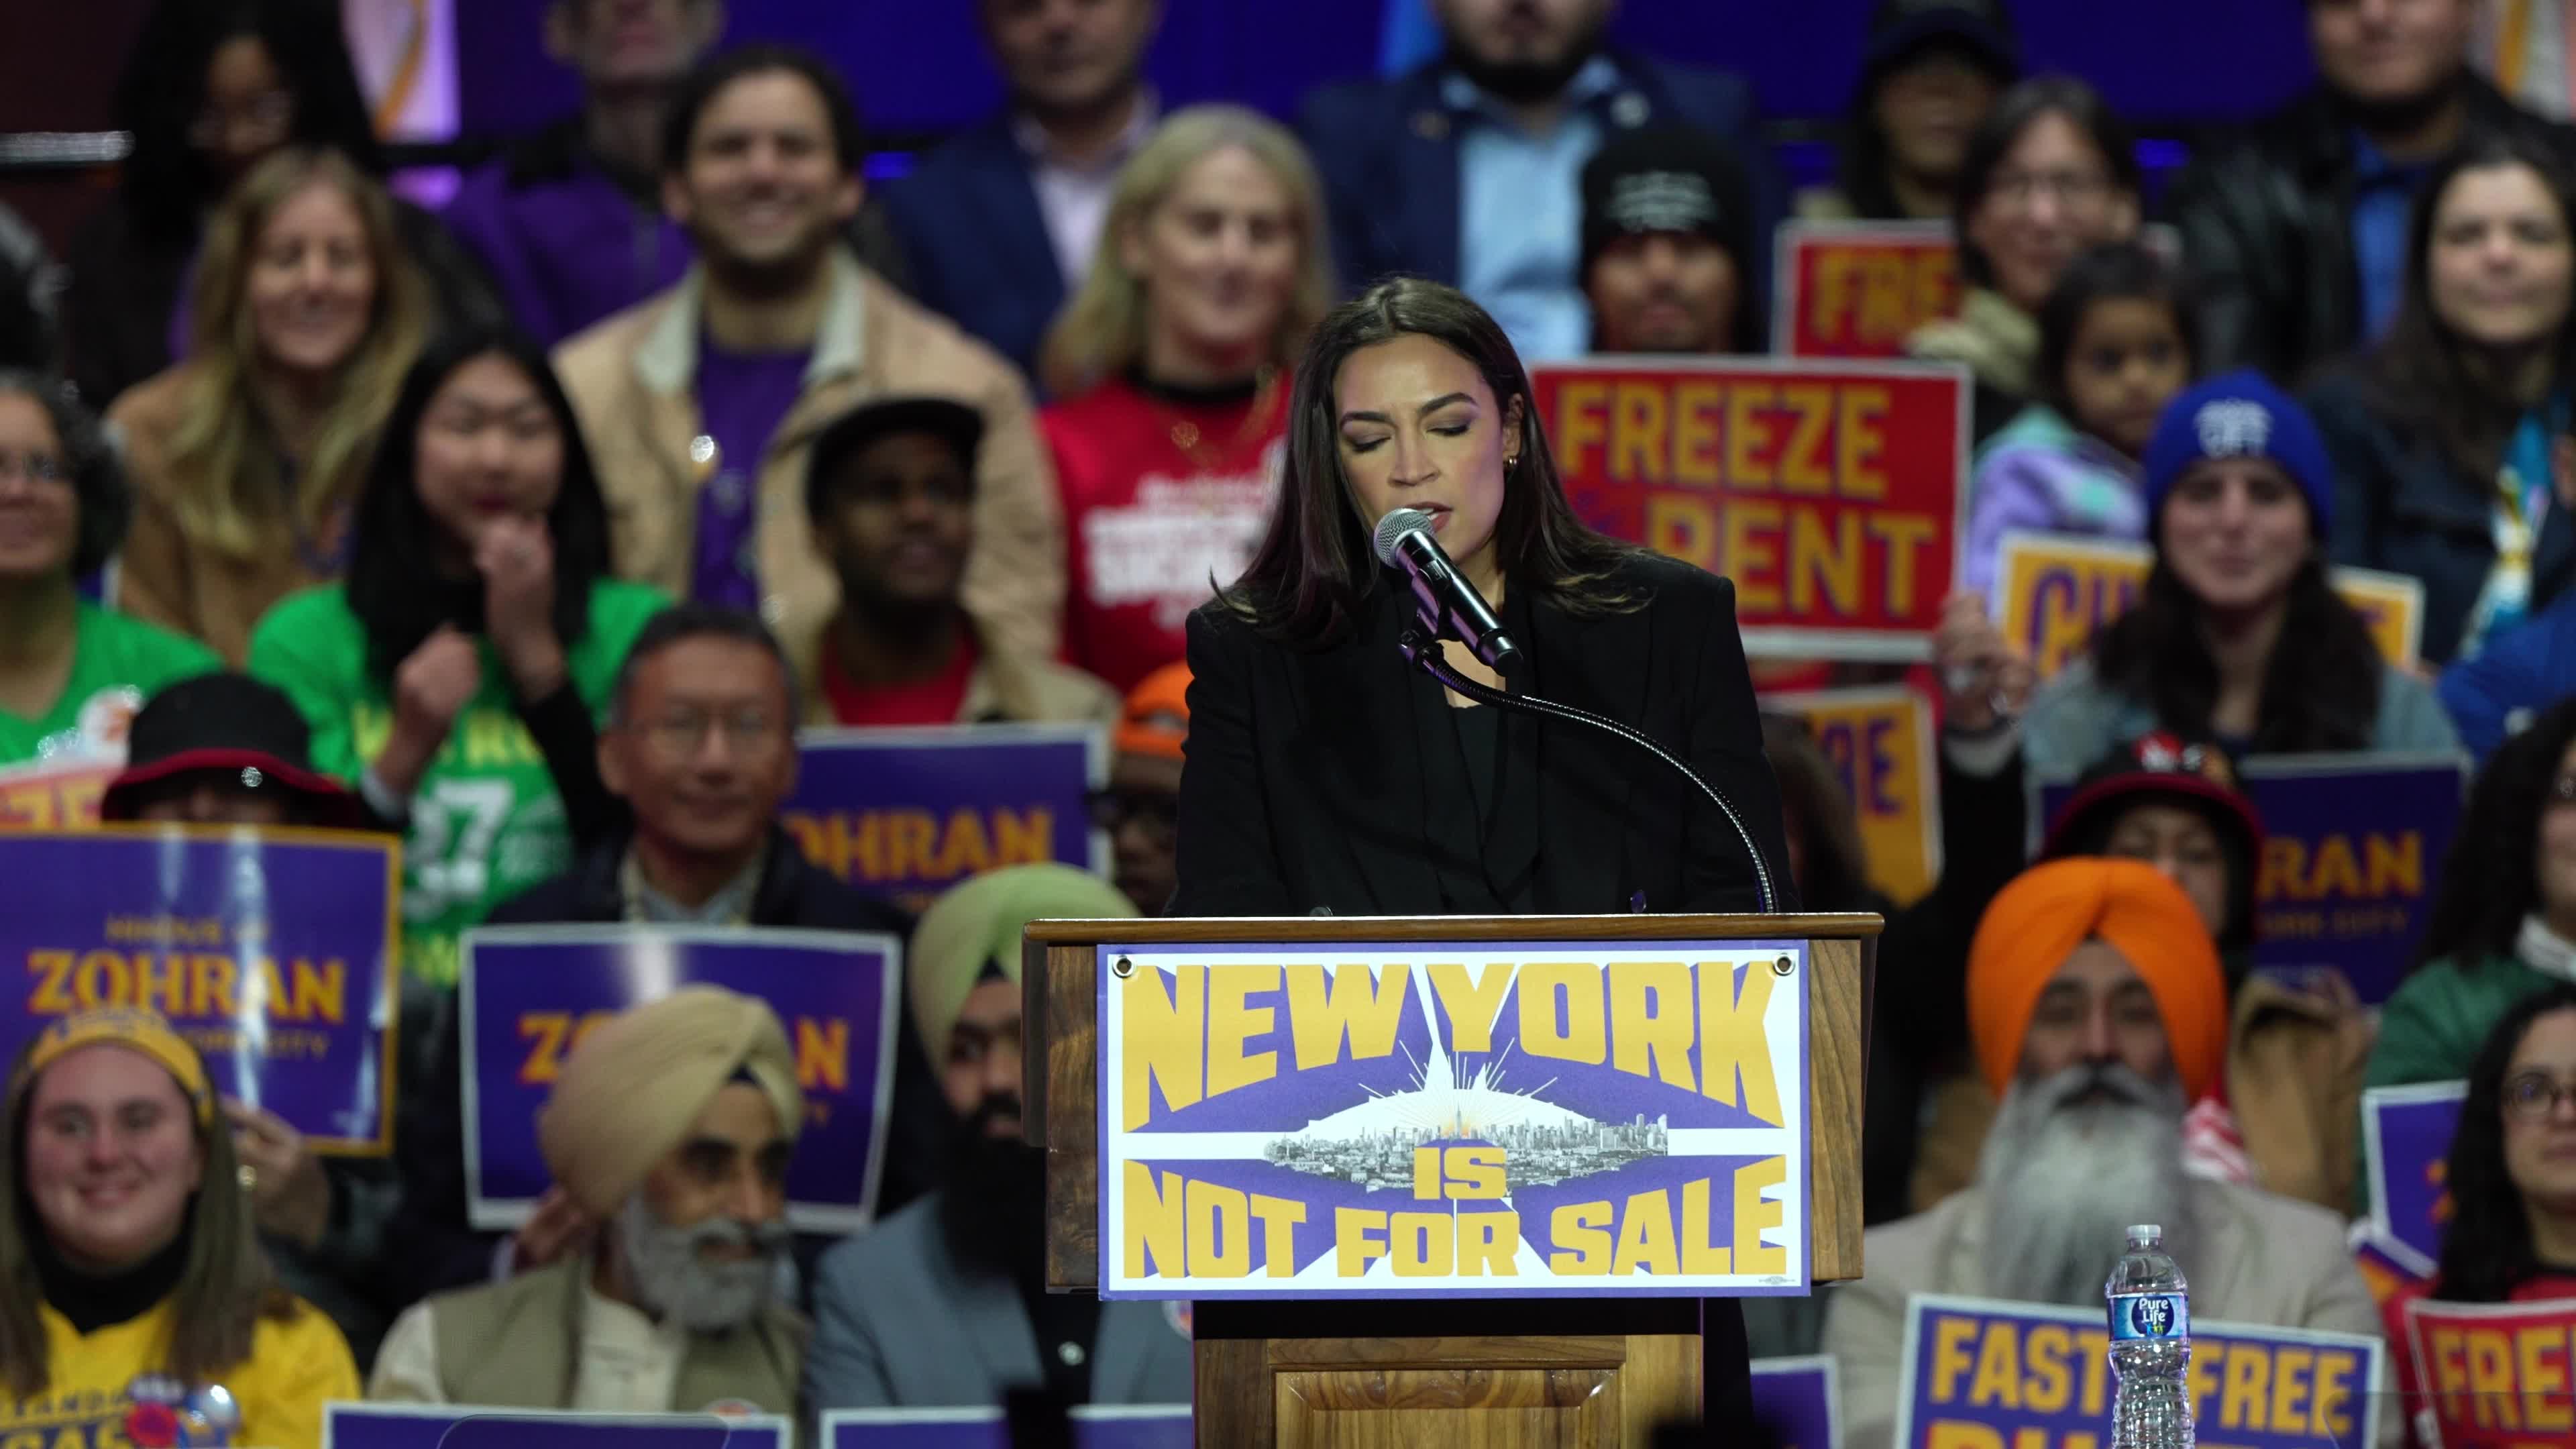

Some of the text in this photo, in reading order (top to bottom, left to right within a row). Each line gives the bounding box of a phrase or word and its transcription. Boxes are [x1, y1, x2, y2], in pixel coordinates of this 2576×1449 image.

[1558, 381, 1890, 504] FREEZE
[2255, 832, 2424, 899] RAN
[27, 947, 346, 1024] ZOHRAN
[1122, 961, 1786, 1133] NEW YORK
[1123, 1154, 1787, 1279] NOT FOR SALE
[1413, 1146, 1507, 1200] IS
[2139, 1297, 2169, 1310] Pure
[2142, 1310, 2166, 1325] Life
[1929, 1316, 2357, 1440] FAST FREE
[2430, 1323, 2576, 1436] FRE
